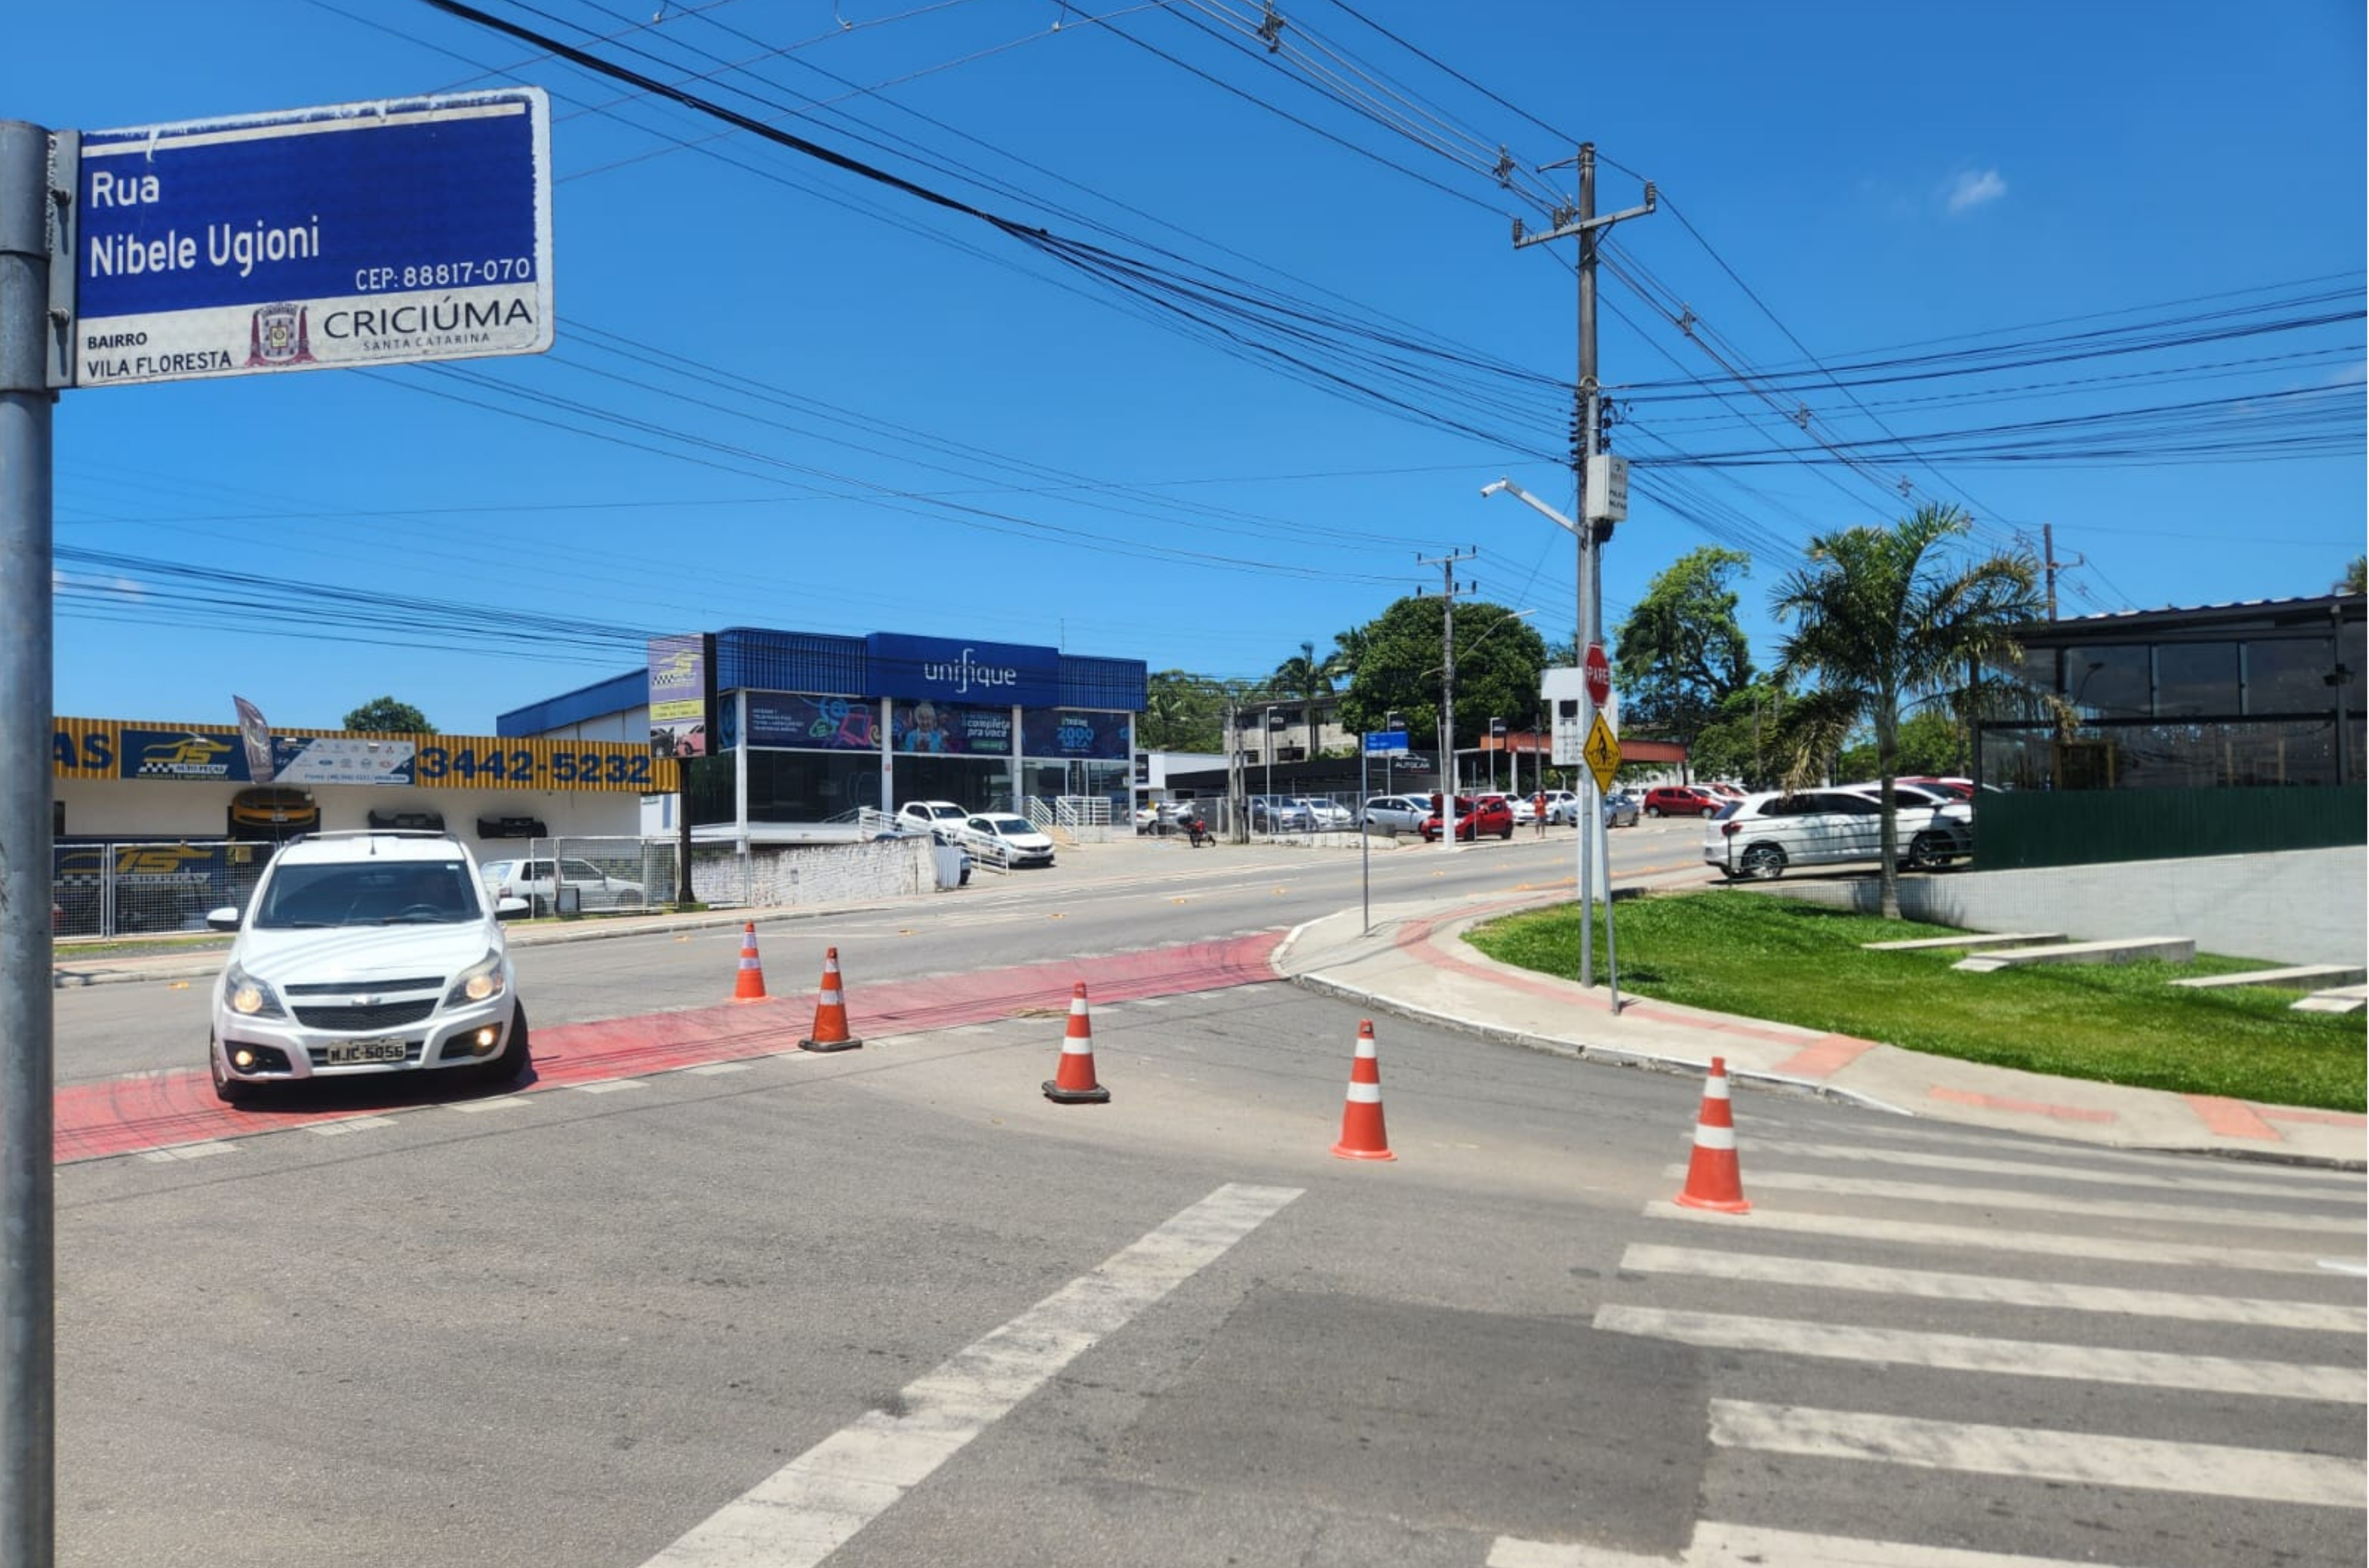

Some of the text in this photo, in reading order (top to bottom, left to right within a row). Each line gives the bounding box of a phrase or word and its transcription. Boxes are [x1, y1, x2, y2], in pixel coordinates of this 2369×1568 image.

[92, 172, 160, 208] Rua
[91, 215, 319, 278] Nibele Ugioni
[356, 258, 530, 290] CEP: 88817-070
[324, 295, 533, 338] CRICIÚMA
[88, 332, 148, 349] BAIRRO
[364, 332, 490, 351] SANTA CATARINA
[88, 350, 232, 378] VILA FLORESTA
[924, 648, 1017, 693] unifique
[1588, 666, 1609, 685] PARE
[968, 728, 983, 737] pra
[1057, 727, 1095, 741] 2000
[419, 747, 651, 785] 3442-5232
